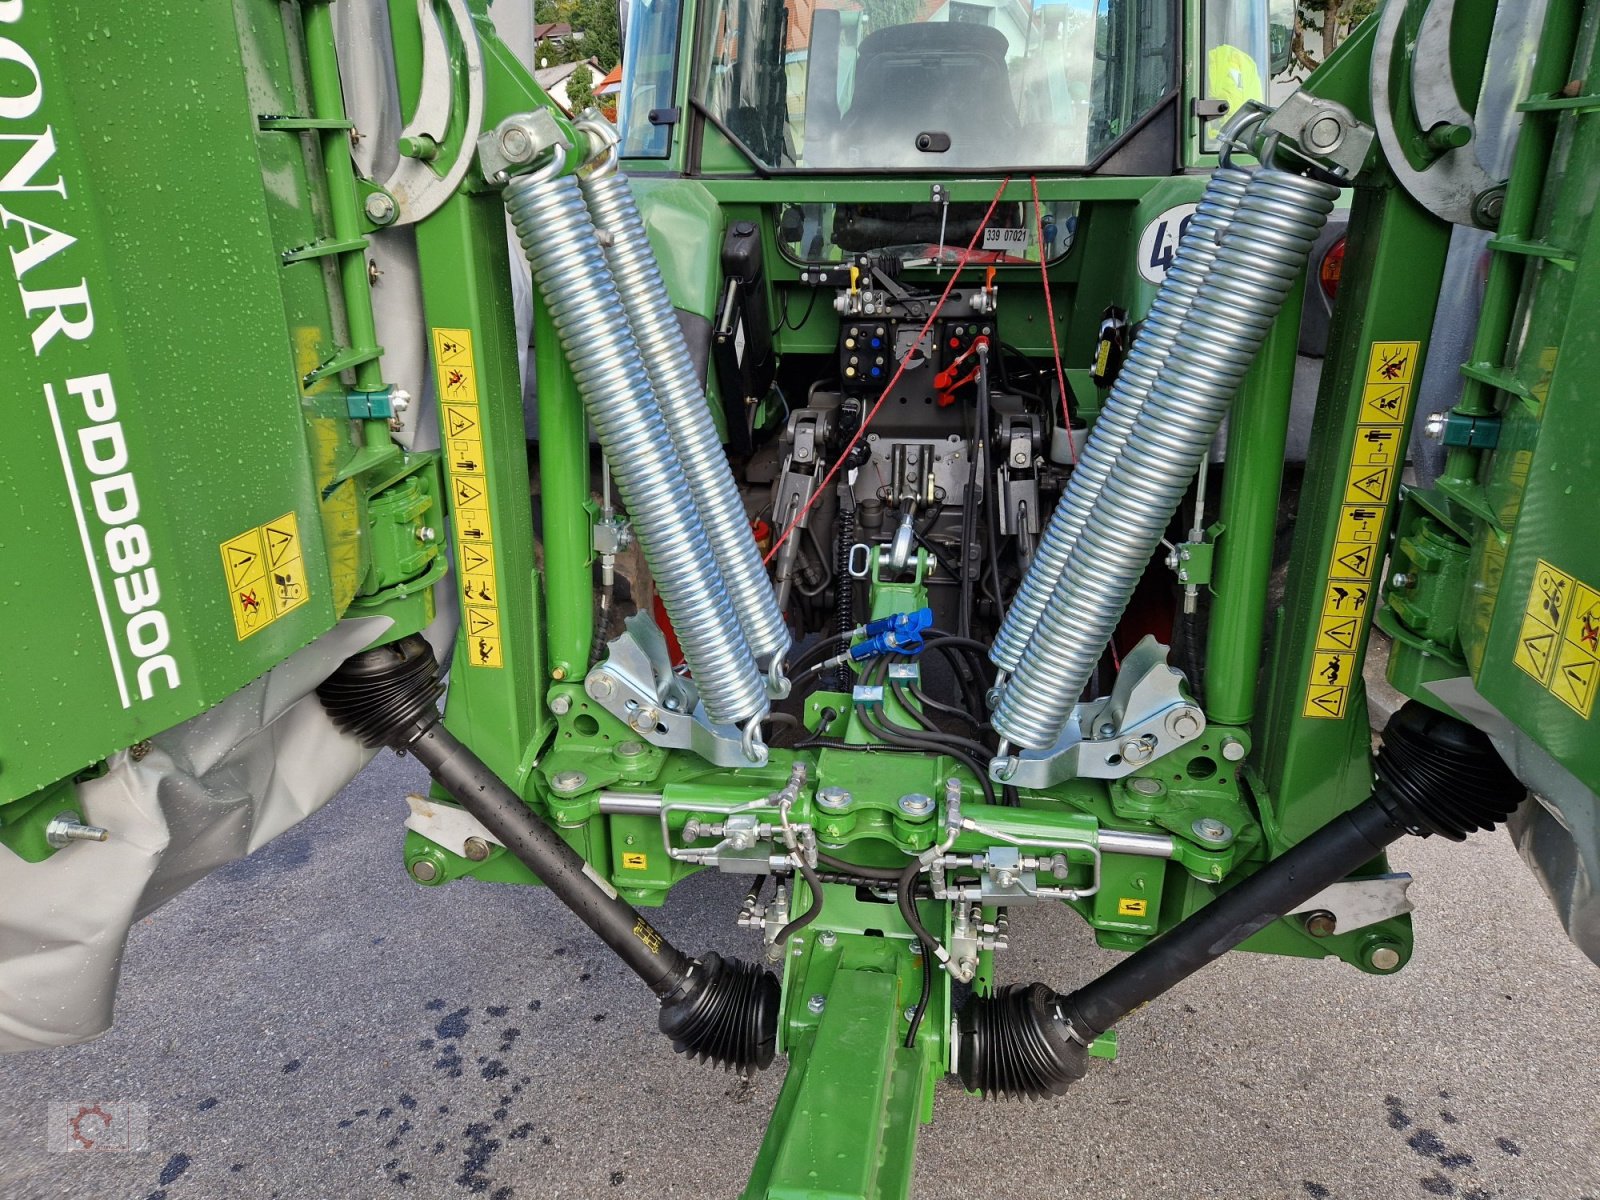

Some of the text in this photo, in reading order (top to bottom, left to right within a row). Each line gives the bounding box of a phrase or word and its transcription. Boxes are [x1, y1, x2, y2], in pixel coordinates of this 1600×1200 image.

[986, 229, 1027, 242] 339 07021
[1150, 213, 1194, 272] 4
[65, 372, 181, 701] PDD830C
